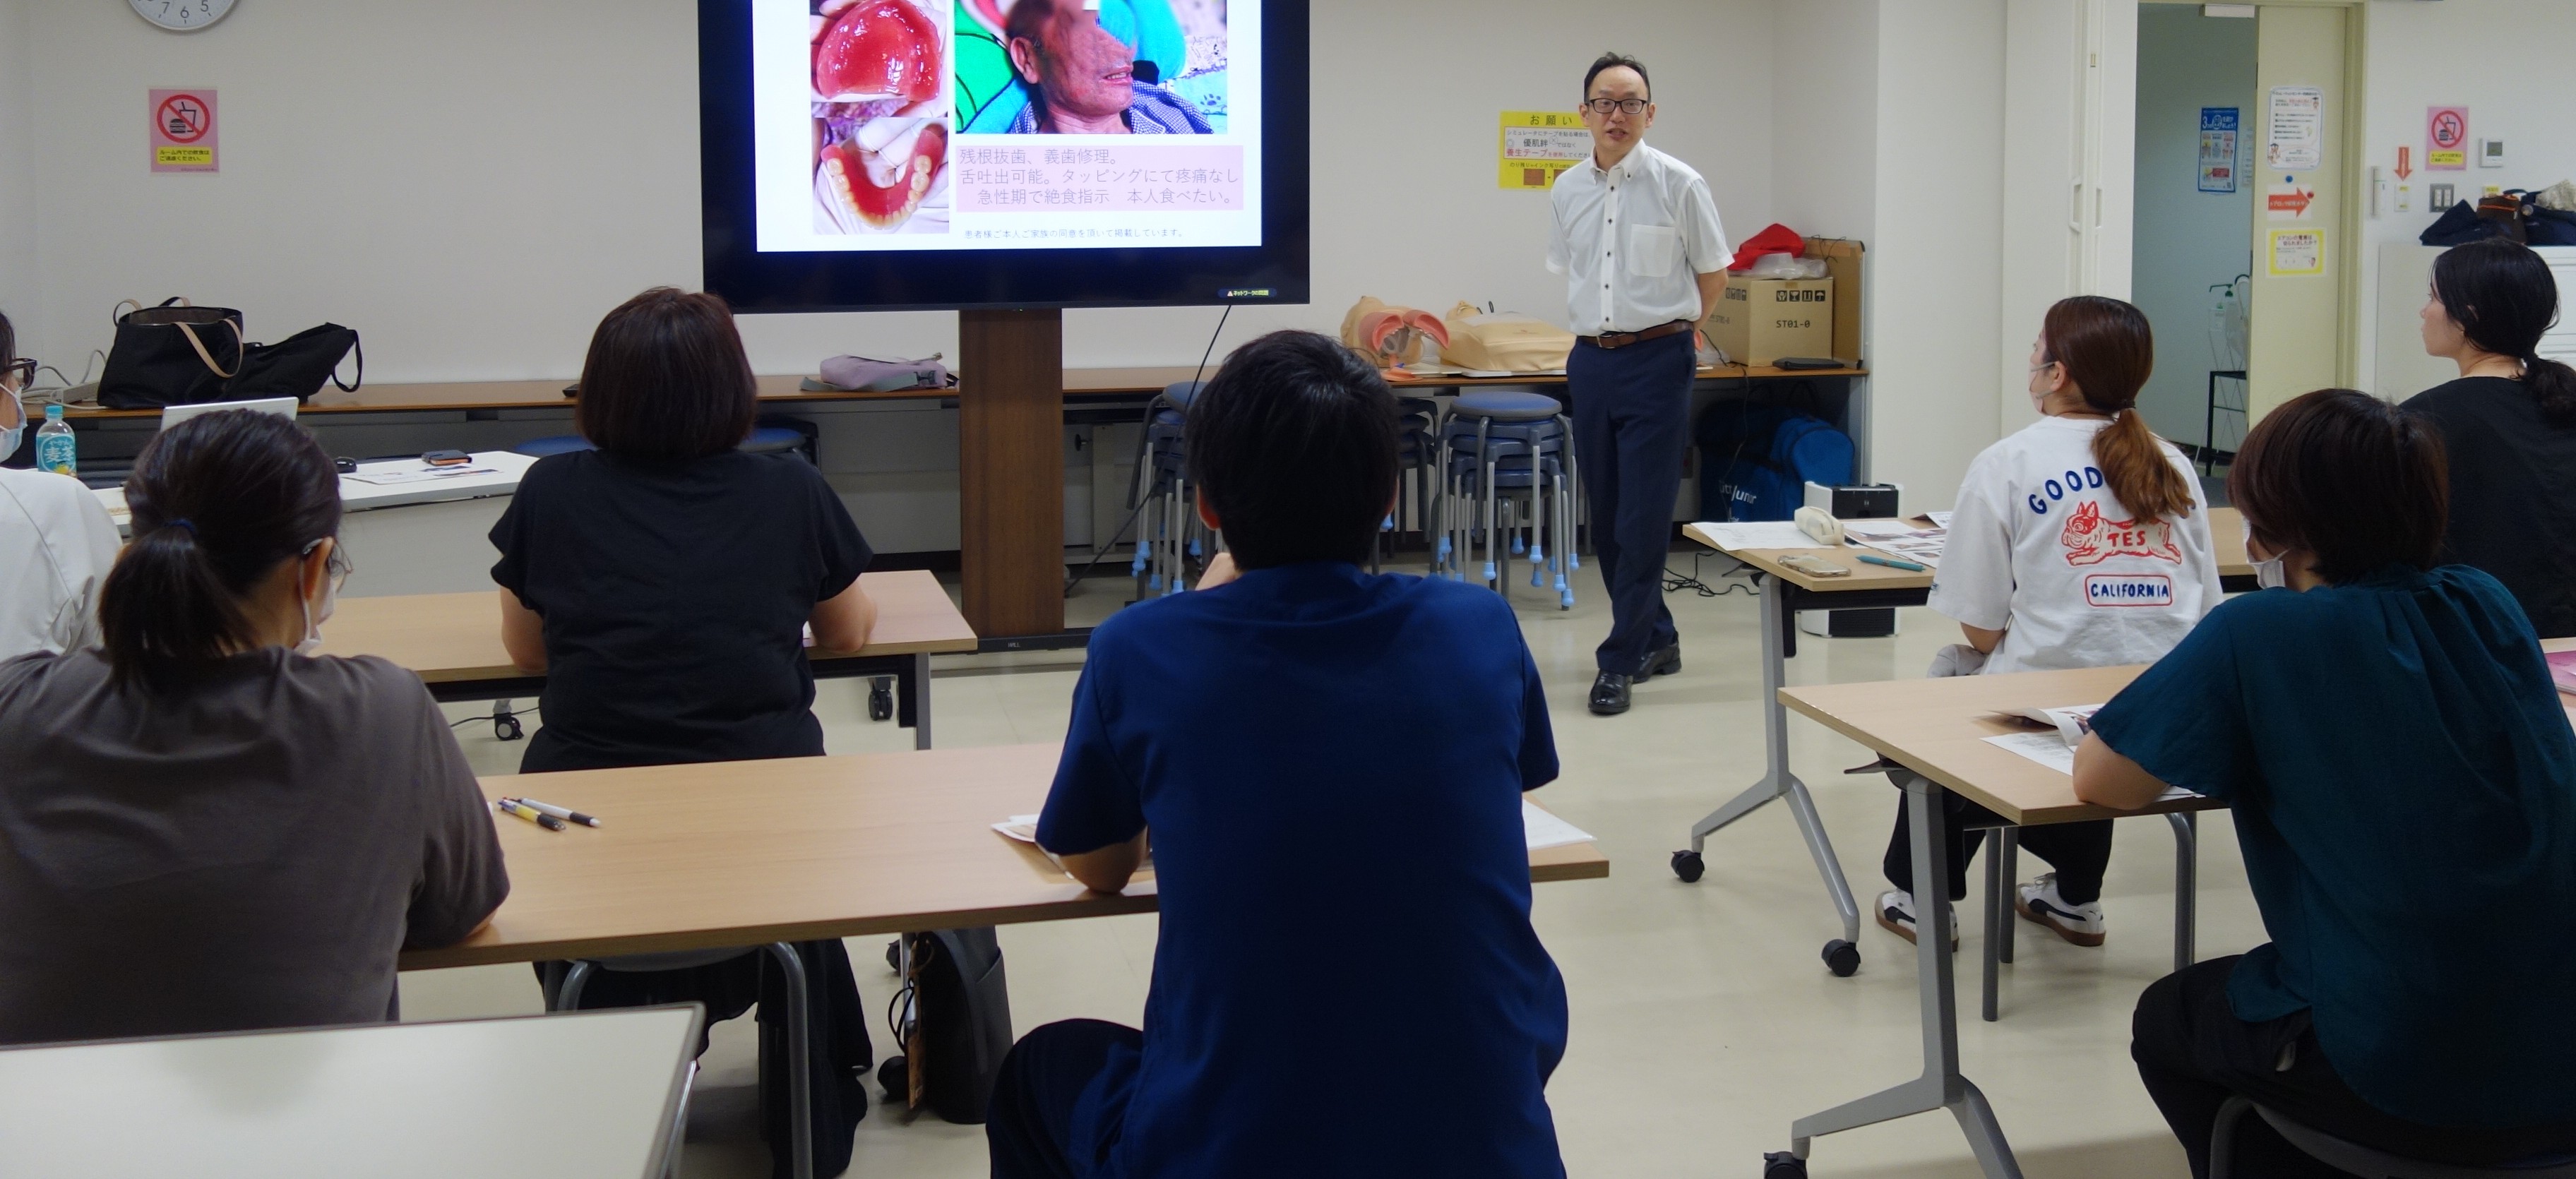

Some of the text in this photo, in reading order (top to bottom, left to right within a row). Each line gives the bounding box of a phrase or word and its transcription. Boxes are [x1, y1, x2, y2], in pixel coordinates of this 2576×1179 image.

[162, 1, 170, 13] 7
[180, 6, 189, 18] 6
[201, 0, 209, 12] 5
[1530, 114, 1573, 126] お願い
[977, 188, 1230, 205] 急性期で絶食指示 本人食べたい。
[1776, 320, 1811, 328] ST01-0
[2029, 466, 2104, 515] GOOD
[2106, 530, 2146, 548] TES
[2090, 582, 2169, 599] CALIFORNIA
